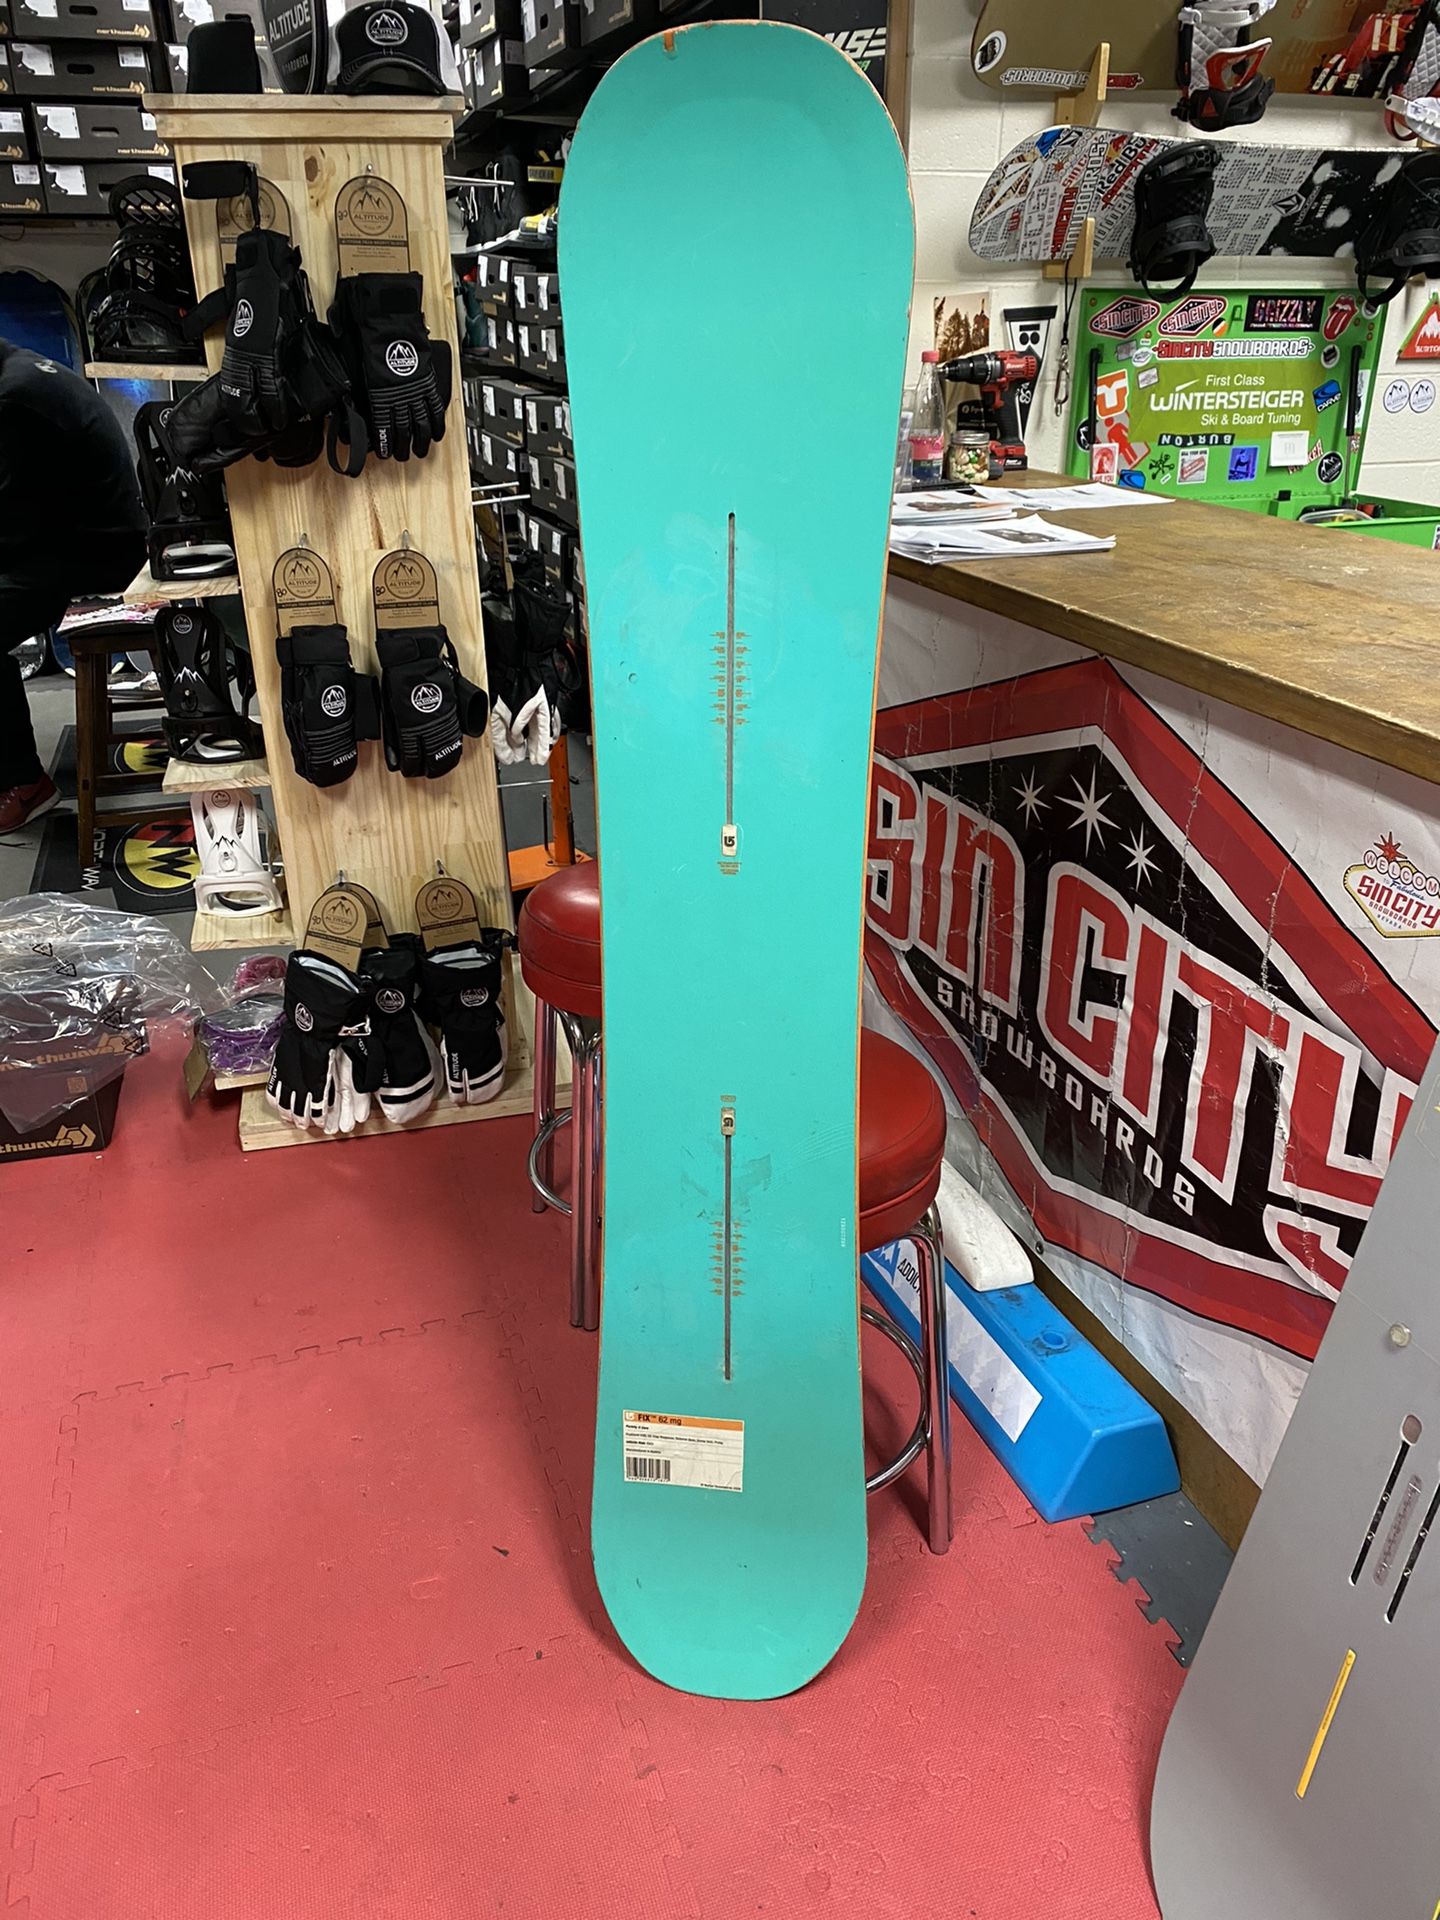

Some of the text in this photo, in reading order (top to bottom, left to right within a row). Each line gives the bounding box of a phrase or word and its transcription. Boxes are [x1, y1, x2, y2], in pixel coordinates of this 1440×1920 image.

[269, 3, 311, 43] ALTITUDE
[1097, 159, 1126, 194] Red
[1206, 373, 1265, 387] First Class
[1150, 388, 1304, 411] WINTERSTEIGER
[1201, 412, 1302, 427] Ski & Board Tuning
[1160, 434, 1233, 446] BURTON
[1365, 852, 1440, 895] WELCOM
[937, 977, 1197, 1217] SNOWBOARDS
[658, 1416, 668, 1424] 62
[669, 1418, 682, 1426] mg
